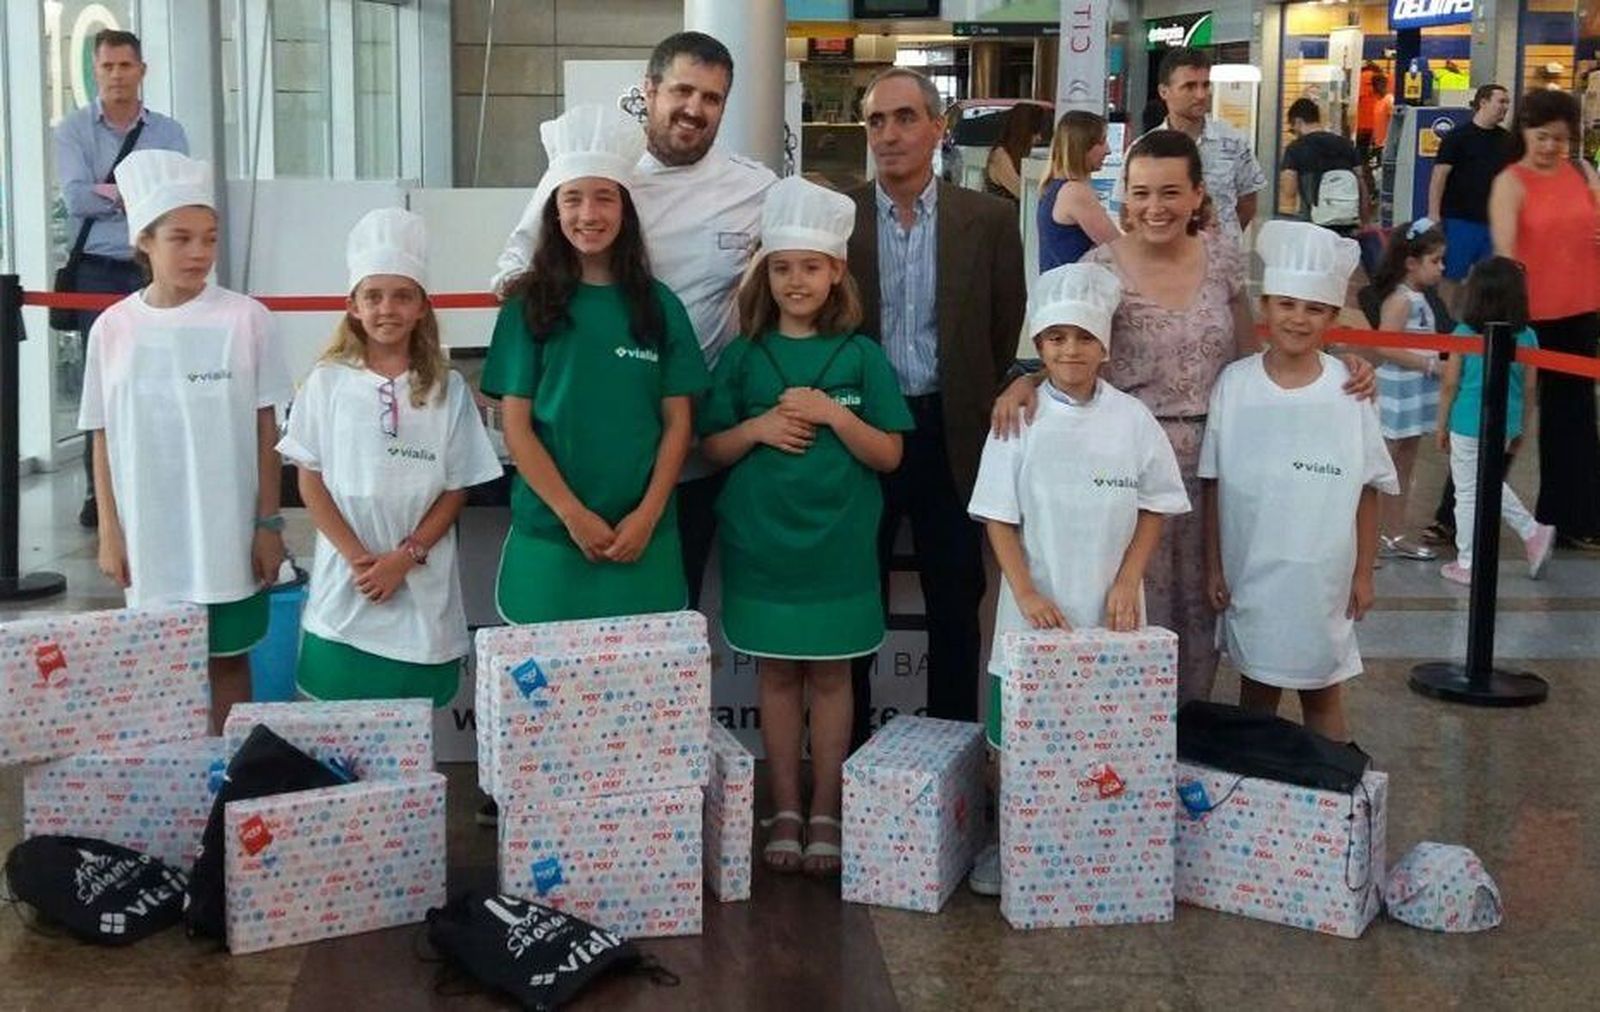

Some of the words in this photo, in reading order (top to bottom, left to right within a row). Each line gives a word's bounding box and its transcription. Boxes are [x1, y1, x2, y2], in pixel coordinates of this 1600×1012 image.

[679, 670, 697, 678] POLY
[653, 832, 672, 840] POLY
[509, 842, 528, 850] POLY
[593, 862, 613, 870] POLY
